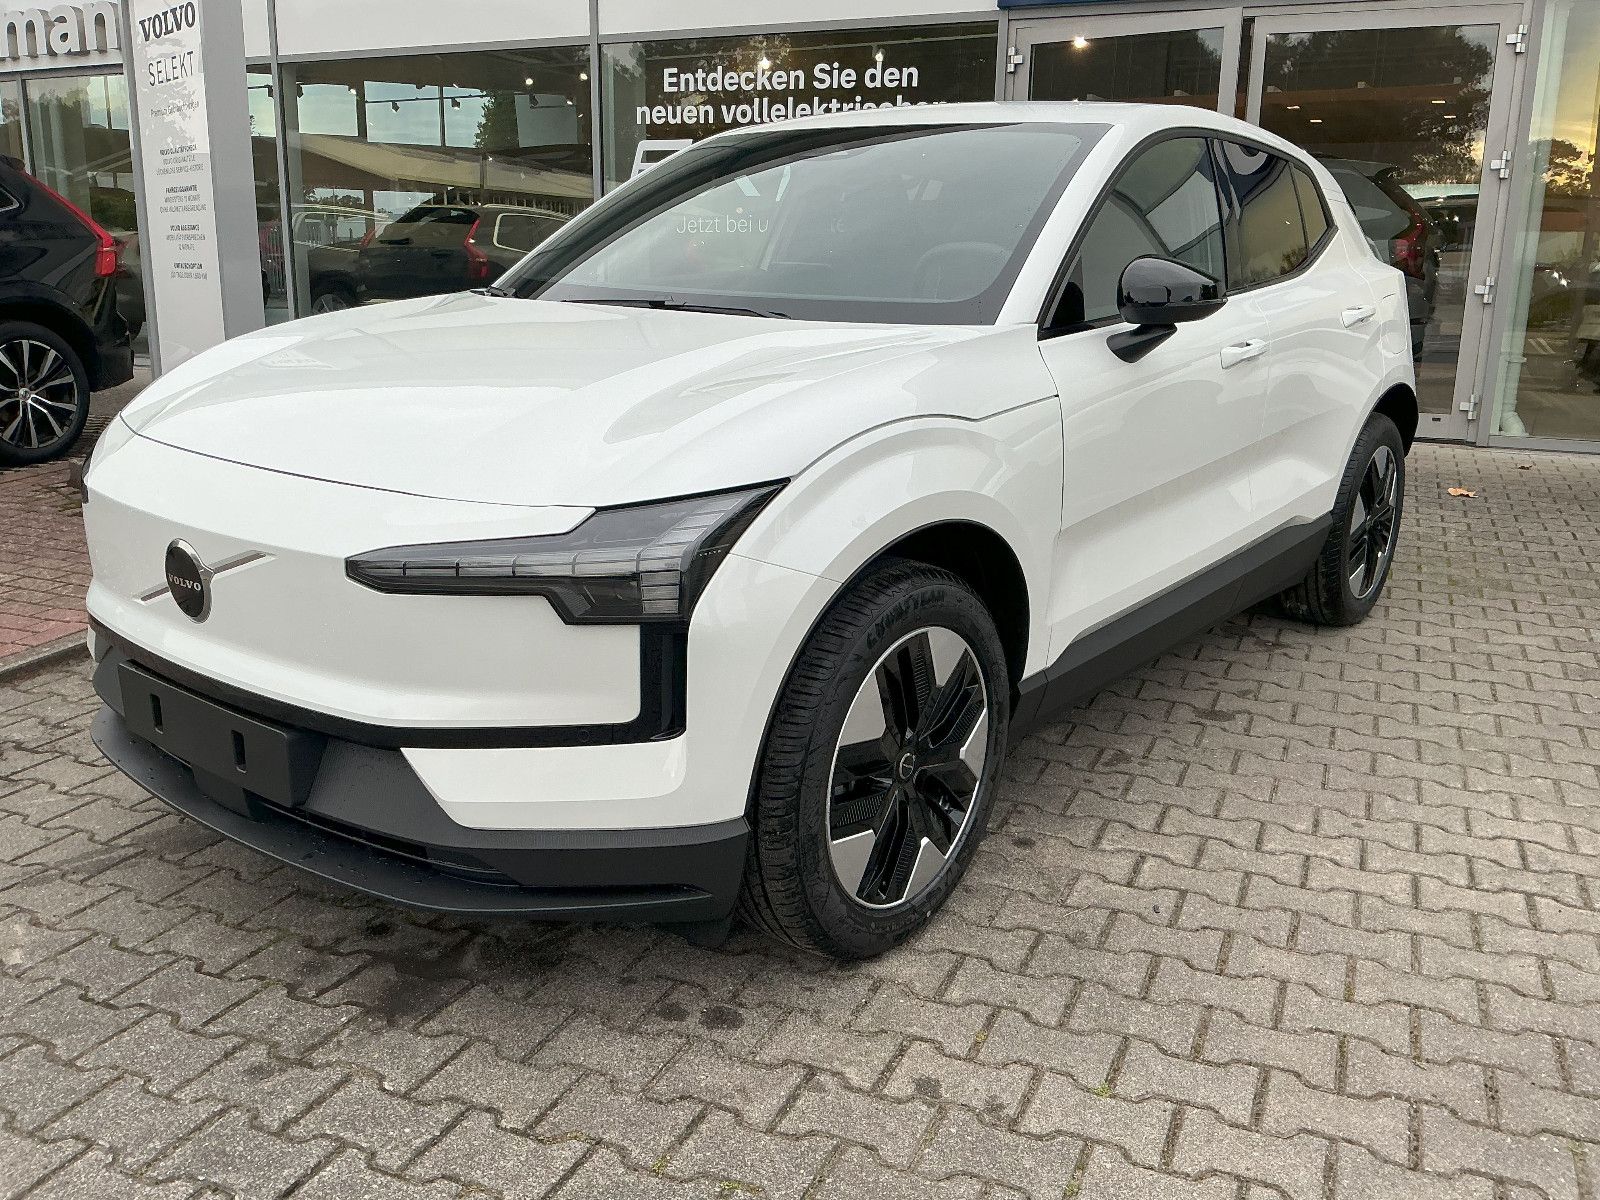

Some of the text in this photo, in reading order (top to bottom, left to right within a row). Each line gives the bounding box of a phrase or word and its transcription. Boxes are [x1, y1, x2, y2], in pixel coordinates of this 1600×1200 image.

[0, 1, 118, 58] man
[139, 2, 196, 42] VOLVO
[148, 50, 194, 87] SELEKT
[663, 61, 919, 92] Entdecken Sie den
[636, 95, 949, 125] neuen vollelektri
[676, 215, 720, 234] Jetzt
[726, 214, 752, 233] bei
[168, 574, 202, 591] VOLVO
